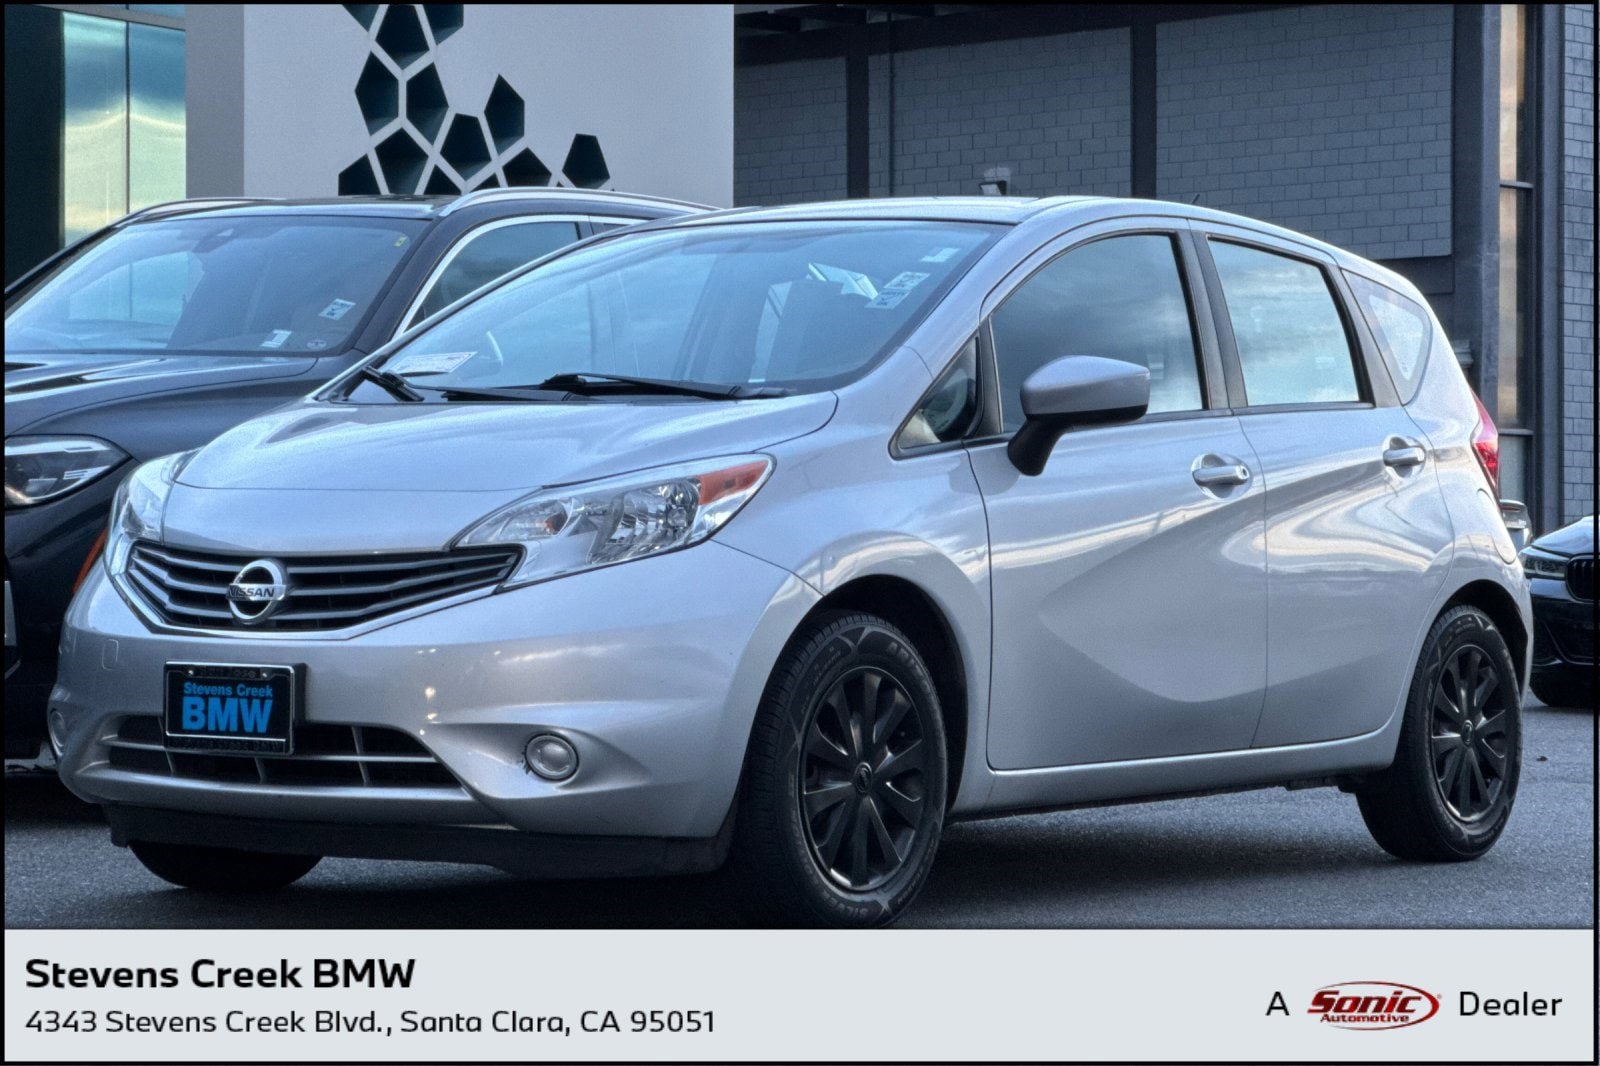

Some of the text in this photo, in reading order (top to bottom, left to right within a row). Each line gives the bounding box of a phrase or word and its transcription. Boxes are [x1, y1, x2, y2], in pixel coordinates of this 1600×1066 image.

[228, 587, 275, 598] NISSAN
[183, 682, 273, 696] Stevens Creek
[182, 697, 273, 733] BMW
